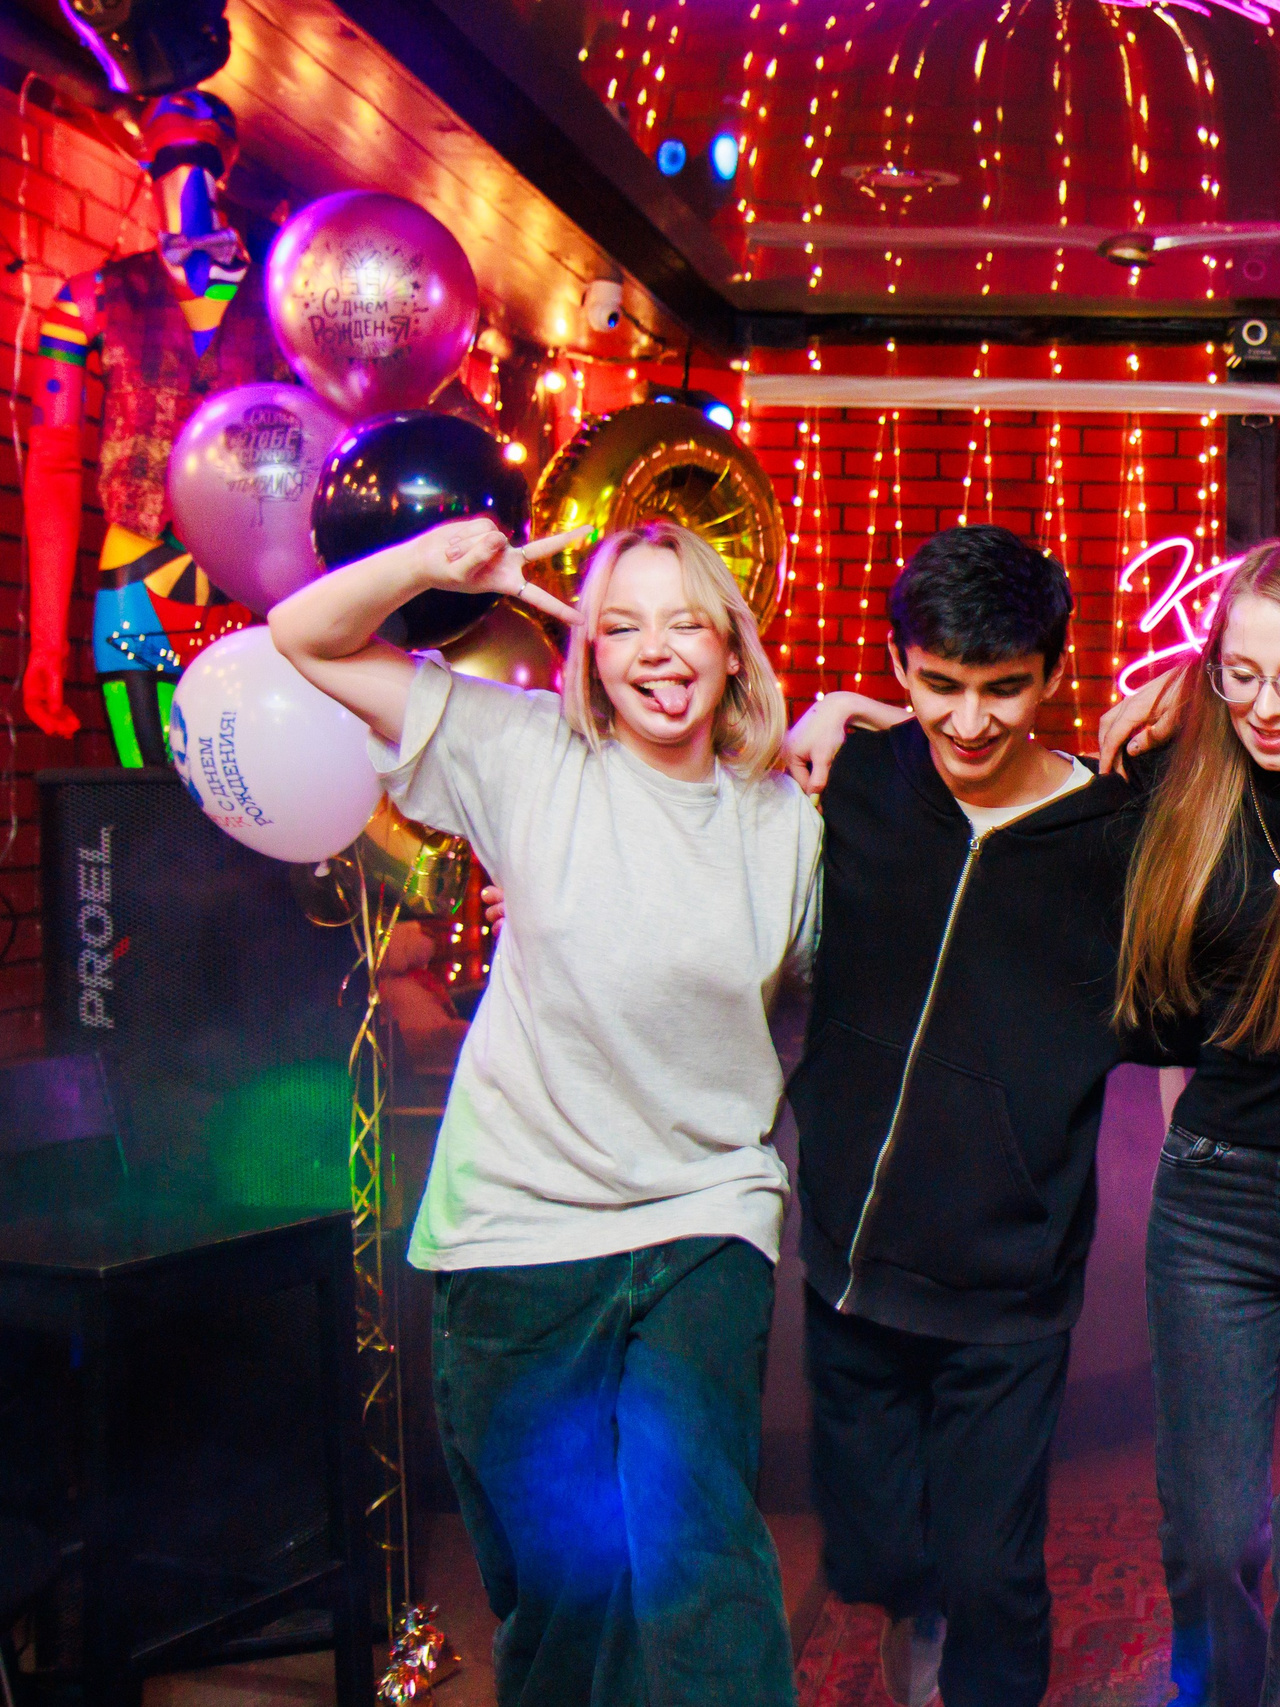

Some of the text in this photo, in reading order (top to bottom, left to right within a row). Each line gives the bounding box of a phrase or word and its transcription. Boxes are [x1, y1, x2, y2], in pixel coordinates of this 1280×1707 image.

[322, 287, 340, 318] С
[198, 736, 231, 798] ДНЕМ
[219, 711, 274, 826] РОЖДЕНИЯ!
[218, 800, 235, 812] С
[79, 827, 114, 1028] PROEL
